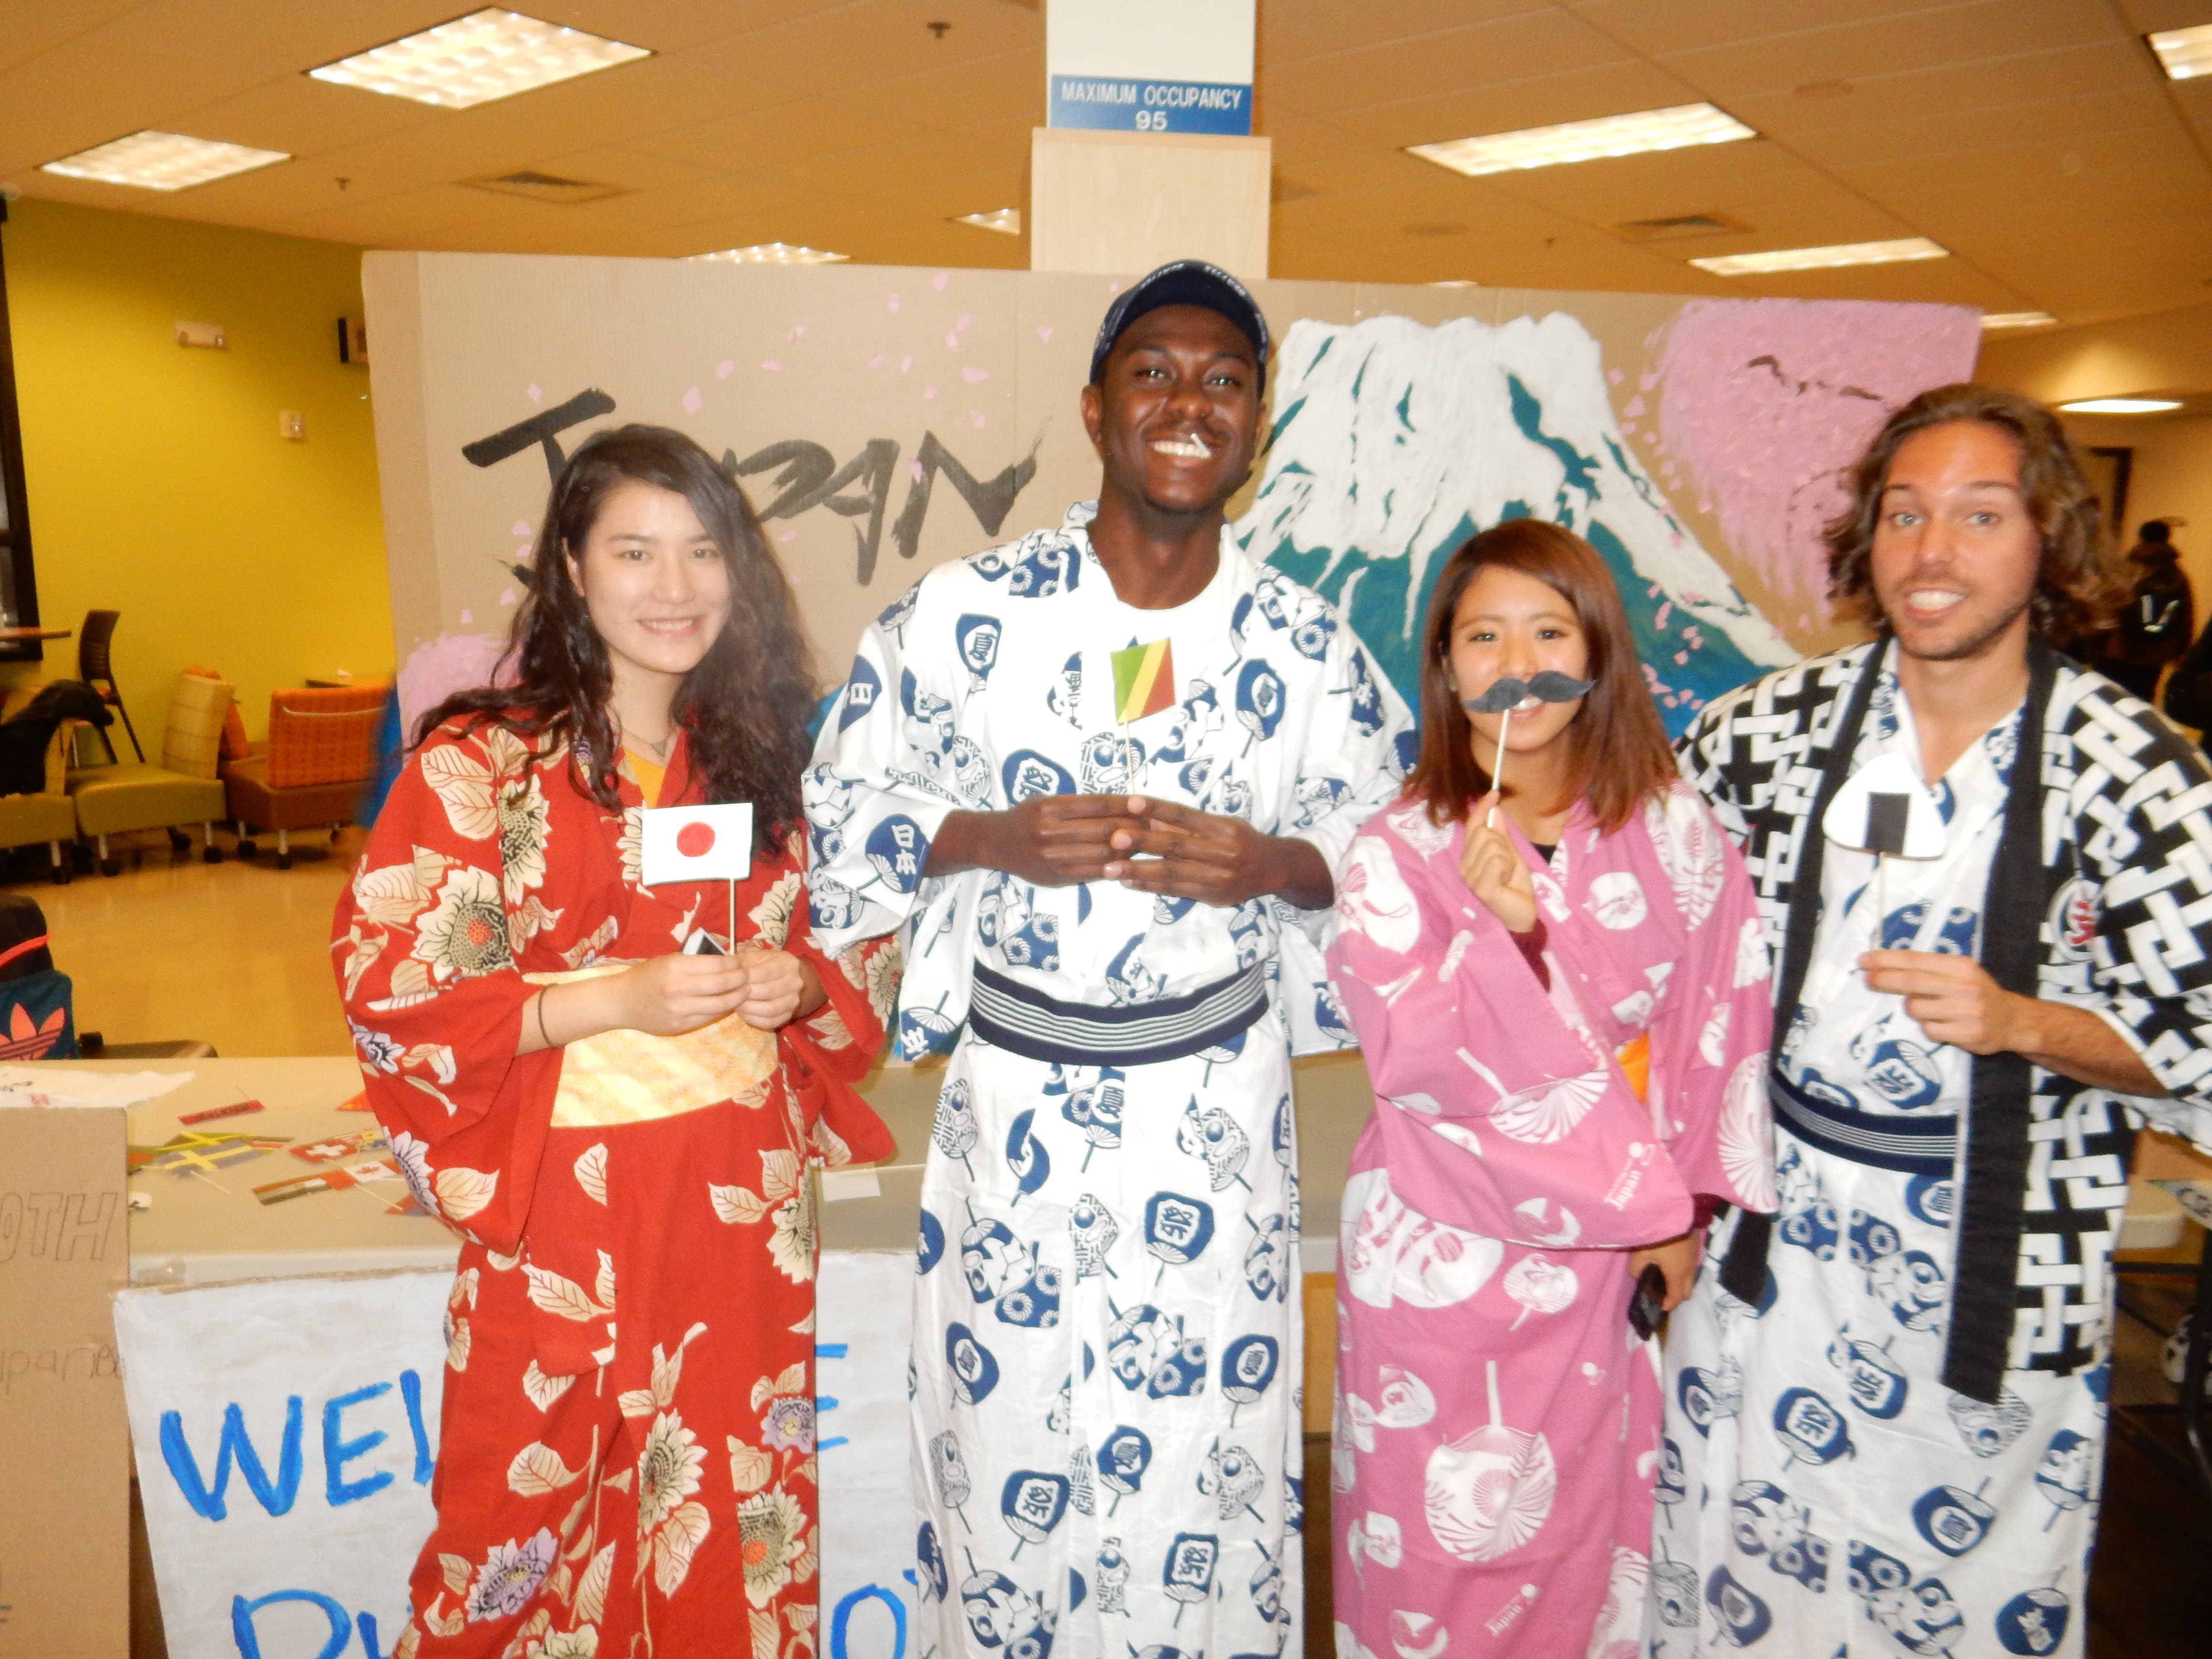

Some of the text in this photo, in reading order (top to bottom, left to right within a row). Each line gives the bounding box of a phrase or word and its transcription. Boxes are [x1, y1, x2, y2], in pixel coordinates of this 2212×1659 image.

[1061, 81, 1243, 110] MAXIMUM OCCUPANCY
[1135, 110, 1168, 131] 95
[1603, 1168, 1642, 1212] Japan
[1483, 1605, 1522, 1637] Japan
